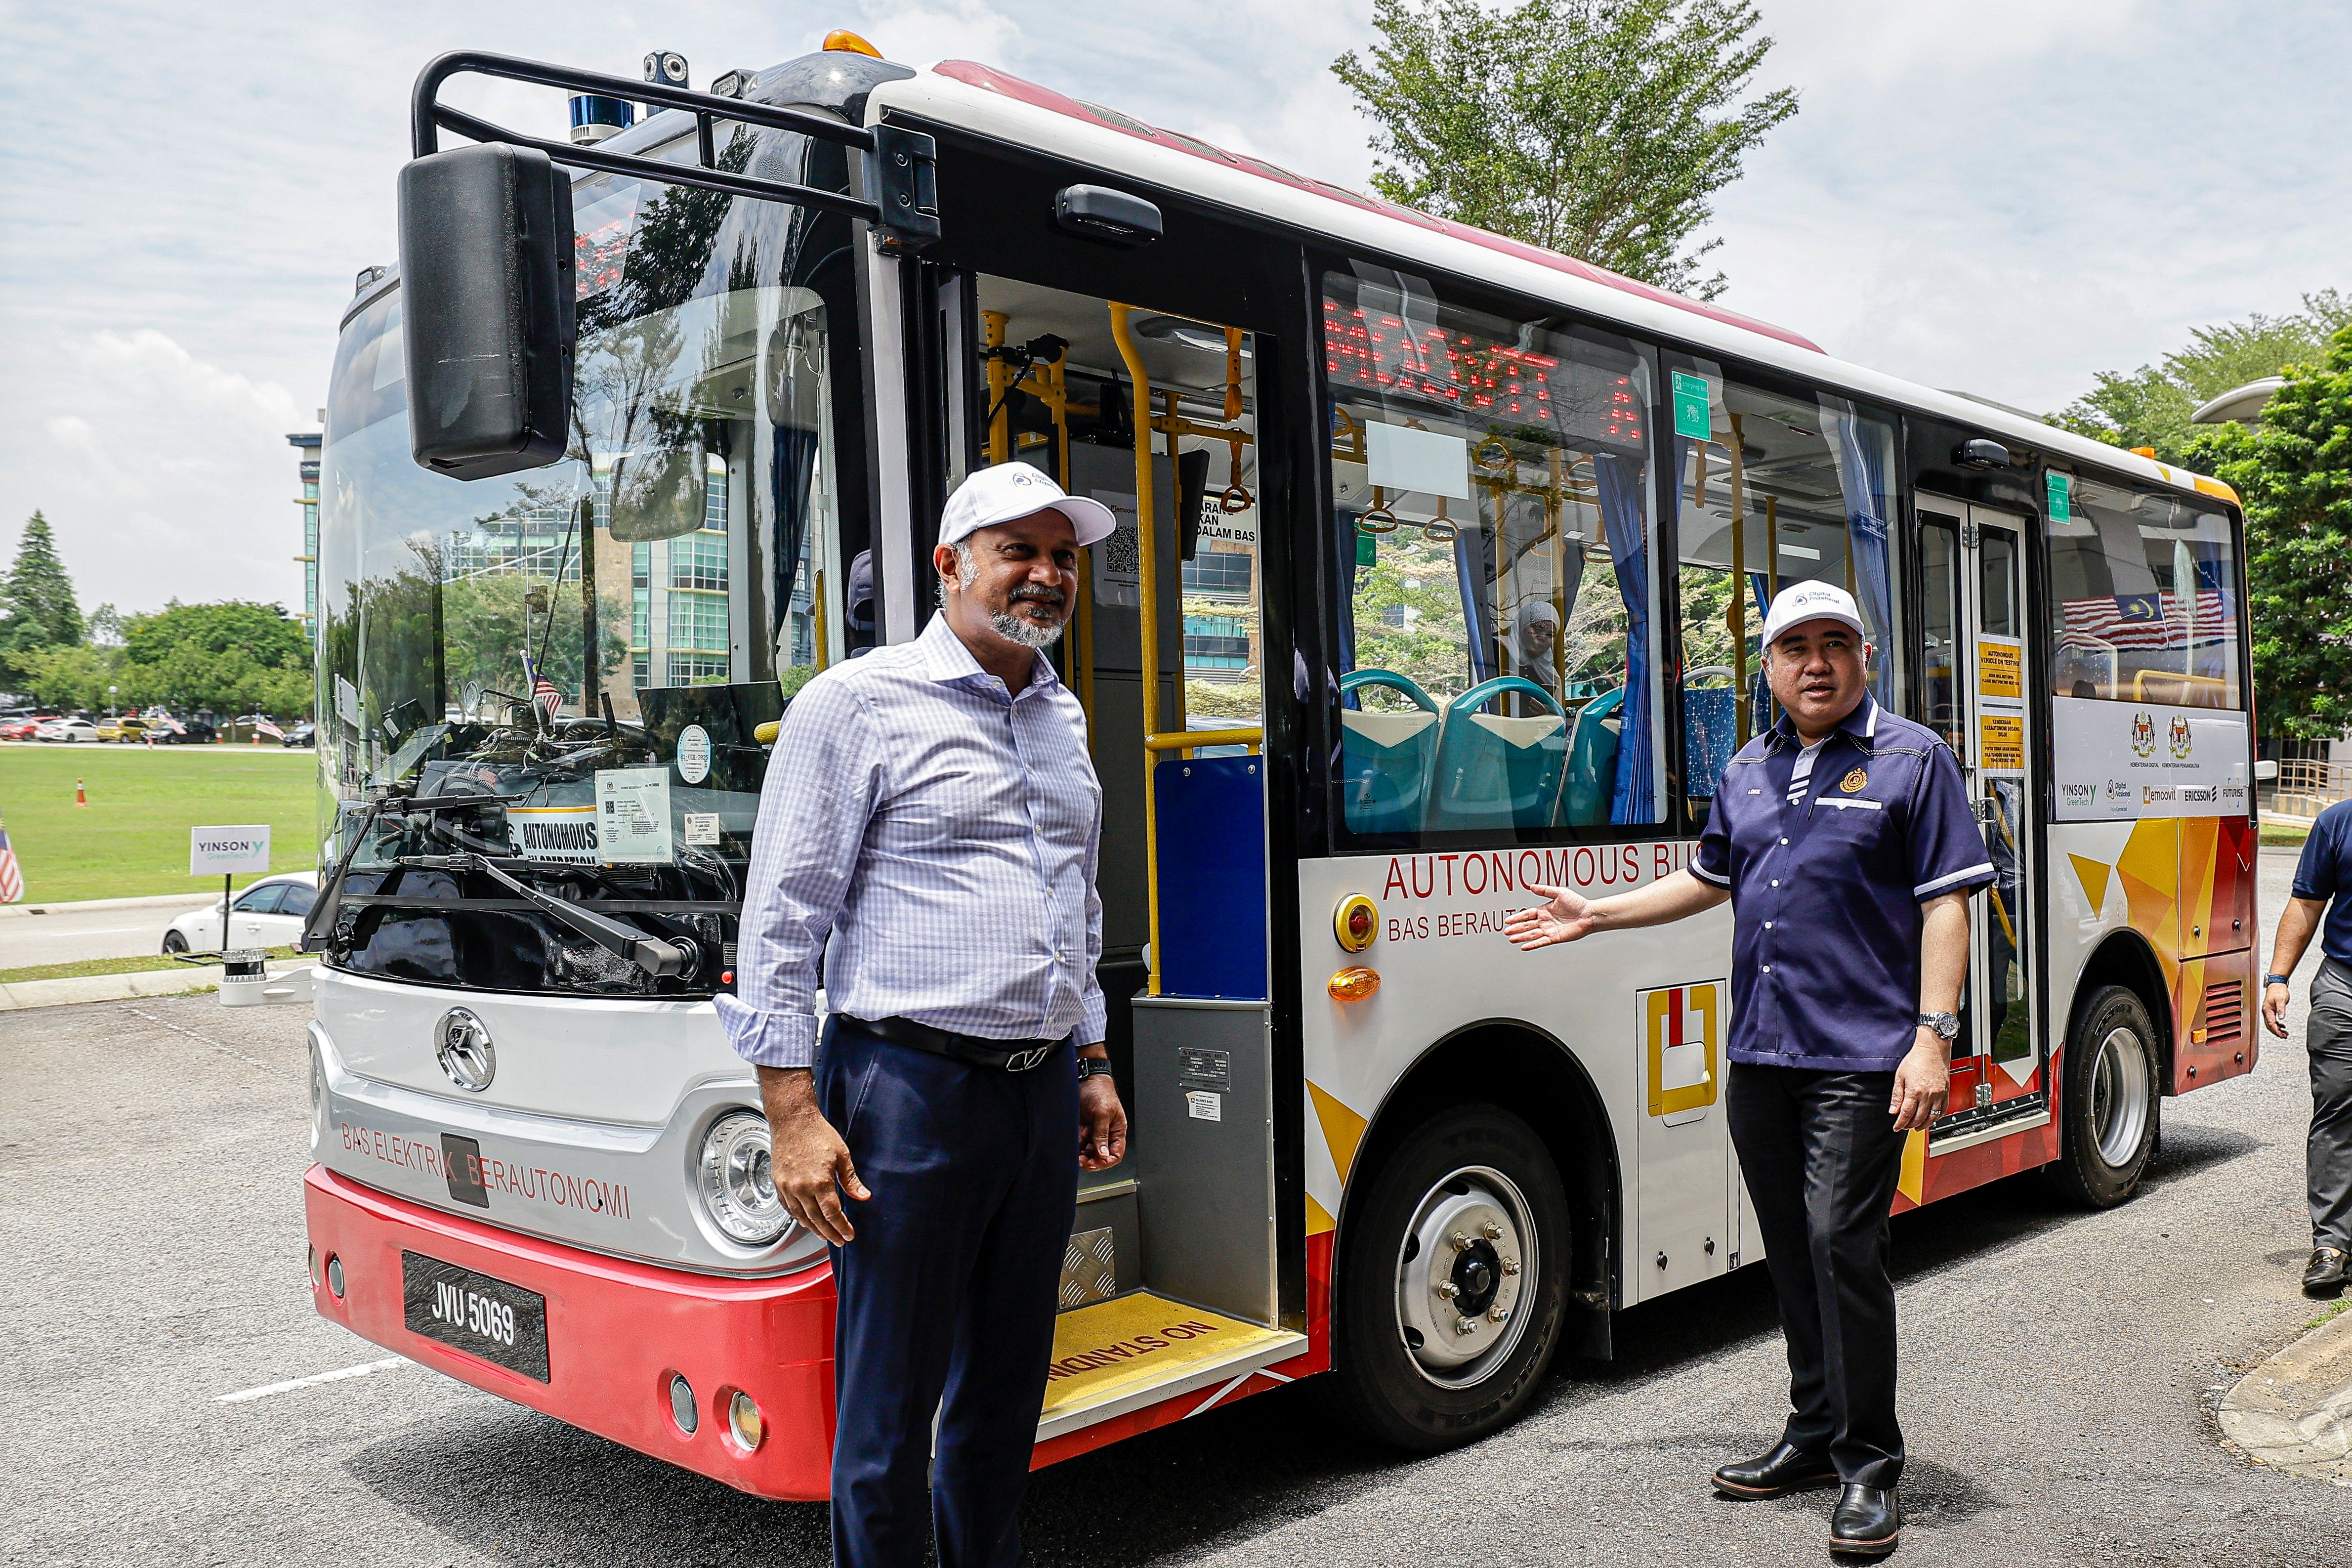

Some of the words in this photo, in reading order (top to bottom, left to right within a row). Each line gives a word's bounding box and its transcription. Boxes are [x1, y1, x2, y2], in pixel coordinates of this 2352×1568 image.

[1235, 529, 1255, 542] BAS
[2061, 784, 2089, 796] YINSON
[2151, 788, 2176, 801] emoovit
[2184, 790, 2211, 801] ERICSSON
[2223, 788, 2244, 797] FUTURISE
[606, 801, 614, 813] BB
[2066, 797, 2089, 806] GreenTech
[522, 822, 598, 850] AUTONOMOUS
[199, 841, 249, 852] YINSON
[1383, 846, 1639, 901] AUTONOMOUS
[1388, 916, 1429, 942] BAS
[341, 1122, 371, 1155] BAS
[374, 1131, 458, 1182] ELEKTRIK
[466, 1153, 631, 1220] BERAUTONOMI
[432, 1281, 465, 1327] JVU
[468, 1292, 514, 1346] 5069
[1160, 1320, 1219, 1340] NO
